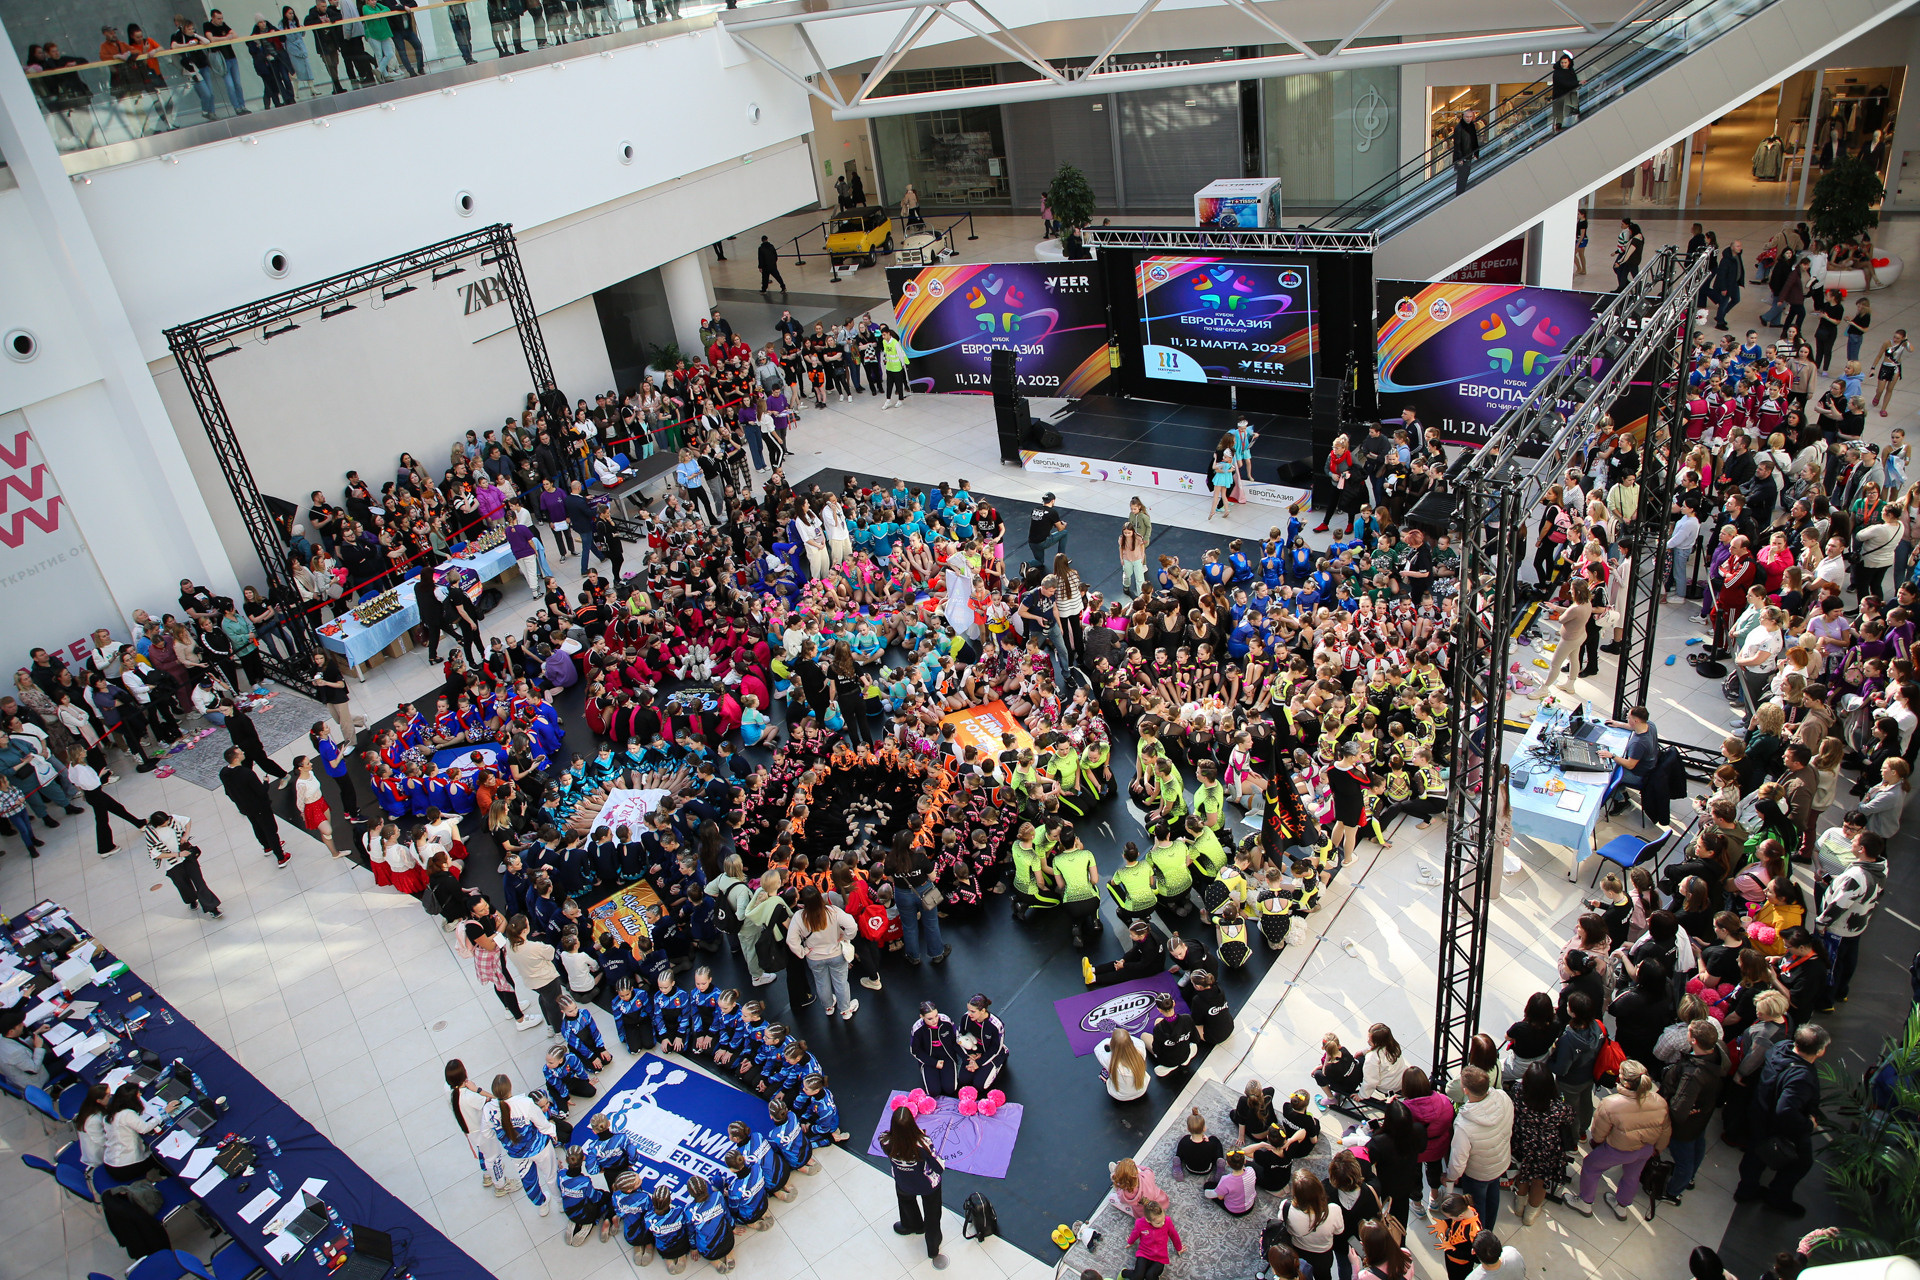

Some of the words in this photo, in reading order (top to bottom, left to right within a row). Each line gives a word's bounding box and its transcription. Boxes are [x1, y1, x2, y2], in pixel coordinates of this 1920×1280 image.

[1522, 49, 1573, 66] ELI
[1481, 258, 1518, 269] КРЕСЛА
[1047, 276, 1090, 286] VEER
[1461, 270, 1486, 280] ЗАЛЕ
[1180, 315, 1272, 329] ЕВРОПА-АЗИЯ
[1170, 337, 1183, 347] 11,
[1185, 338, 1198, 347] 12
[1200, 339, 1249, 351] МАРТА
[1251, 343, 1287, 354] 2023
[1241, 360, 1285, 371] VEER
[955, 373, 968, 385] 11,
[969, 374, 981, 384] 12
[1028, 375, 1060, 386] 2023
[1503, 379, 1527, 387] КУБОК
[1442, 419, 1458, 434] 11,
[1461, 421, 1476, 435] 12
[1080, 461, 1091, 475] 2
[1152, 471, 1159, 485] 1
[0, 553, 67, 588] ТКРЫТИЕ
[618, 915, 641, 936] kids
